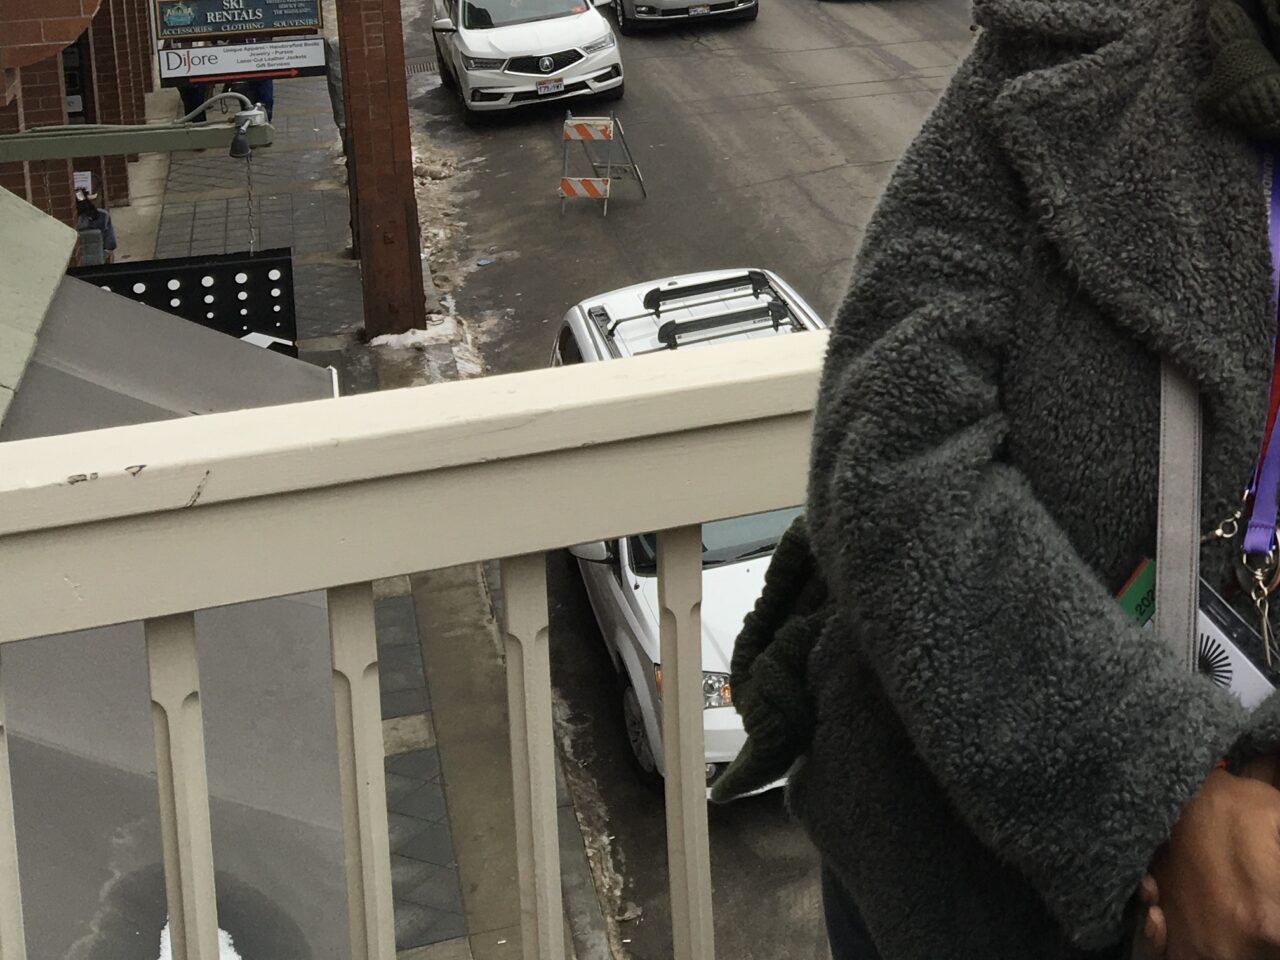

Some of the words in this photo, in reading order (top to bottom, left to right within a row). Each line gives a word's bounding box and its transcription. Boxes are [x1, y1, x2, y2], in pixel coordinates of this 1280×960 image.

[206, 8, 263, 23] RENTALS
[162, 25, 213, 35] ACCESSORIES
[221, 21, 264, 32] CLOTHING
[273, 18, 318, 28] SOUVENIRS
